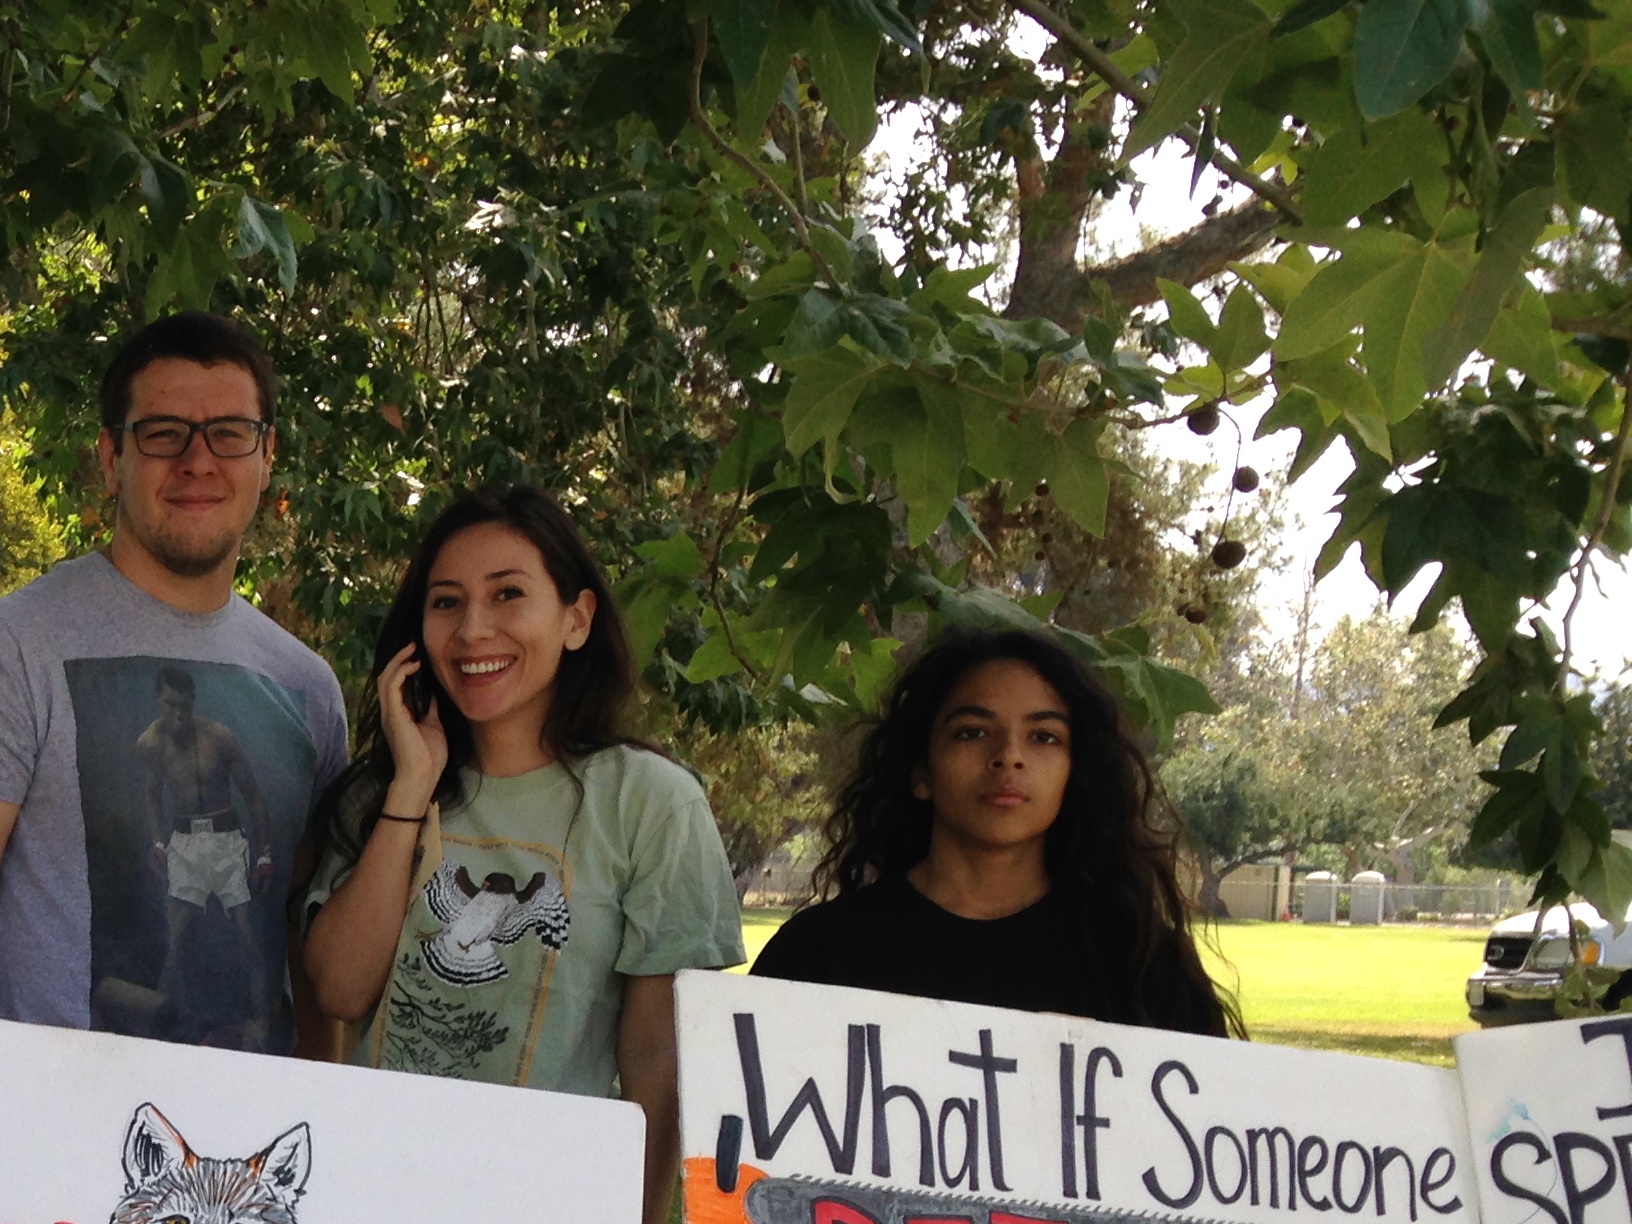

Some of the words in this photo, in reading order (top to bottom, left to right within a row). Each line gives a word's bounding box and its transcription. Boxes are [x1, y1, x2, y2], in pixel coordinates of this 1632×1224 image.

[733, 1012, 1018, 1193] What
[1059, 1042, 1123, 1201] If
[1141, 1060, 1464, 1222] Someone
